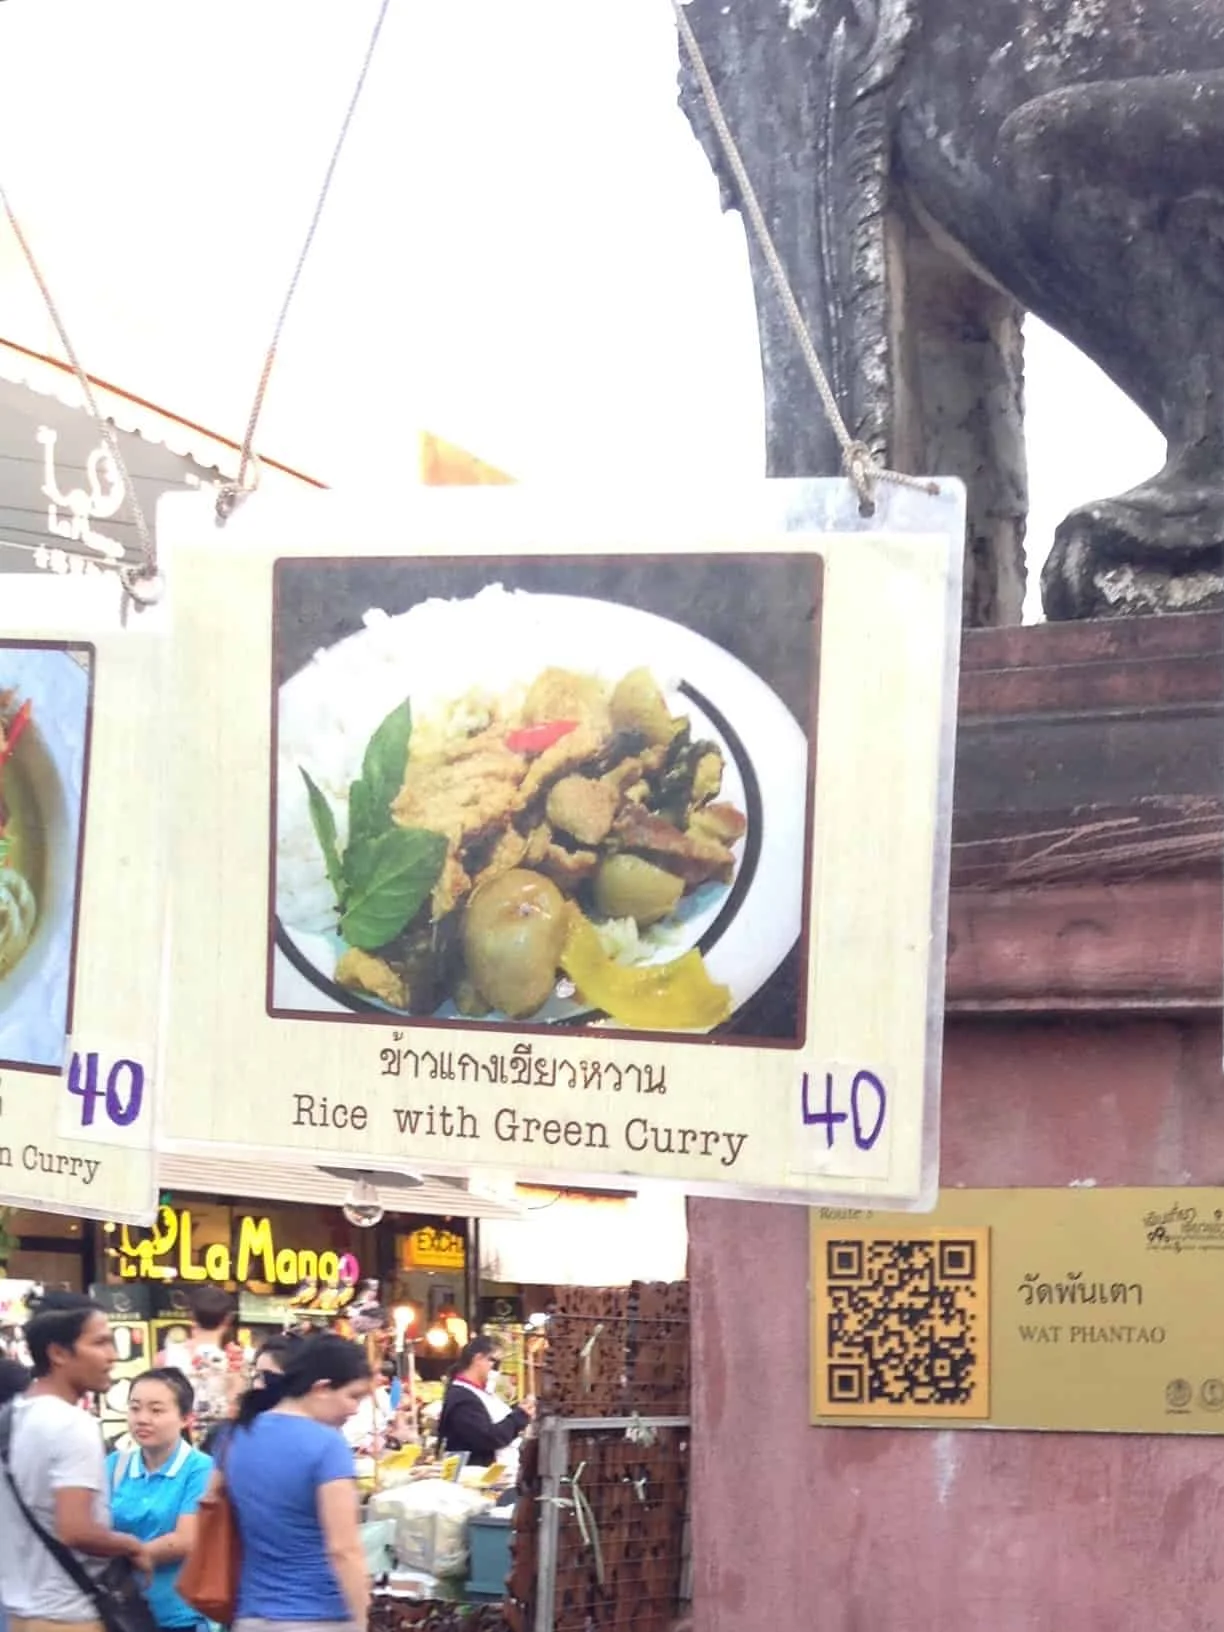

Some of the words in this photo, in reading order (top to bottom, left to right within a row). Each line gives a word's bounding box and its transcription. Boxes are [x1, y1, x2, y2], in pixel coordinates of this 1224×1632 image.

[67, 1051, 145, 1126] 40
[379, 1032, 667, 1095] ข้าวแกงเขียวหวาน
[292, 1093, 368, 1131] Rice
[392, 1104, 481, 1139] with
[494, 1107, 609, 1149] Green
[624, 1117, 749, 1167] Curry
[801, 1068, 888, 1150] 40
[21, 1144, 102, 1185] Curry
[180, 1209, 230, 1281] La
[1018, 1324, 1063, 1344] WAT
[1069, 1324, 1167, 1344] PHANTAO
